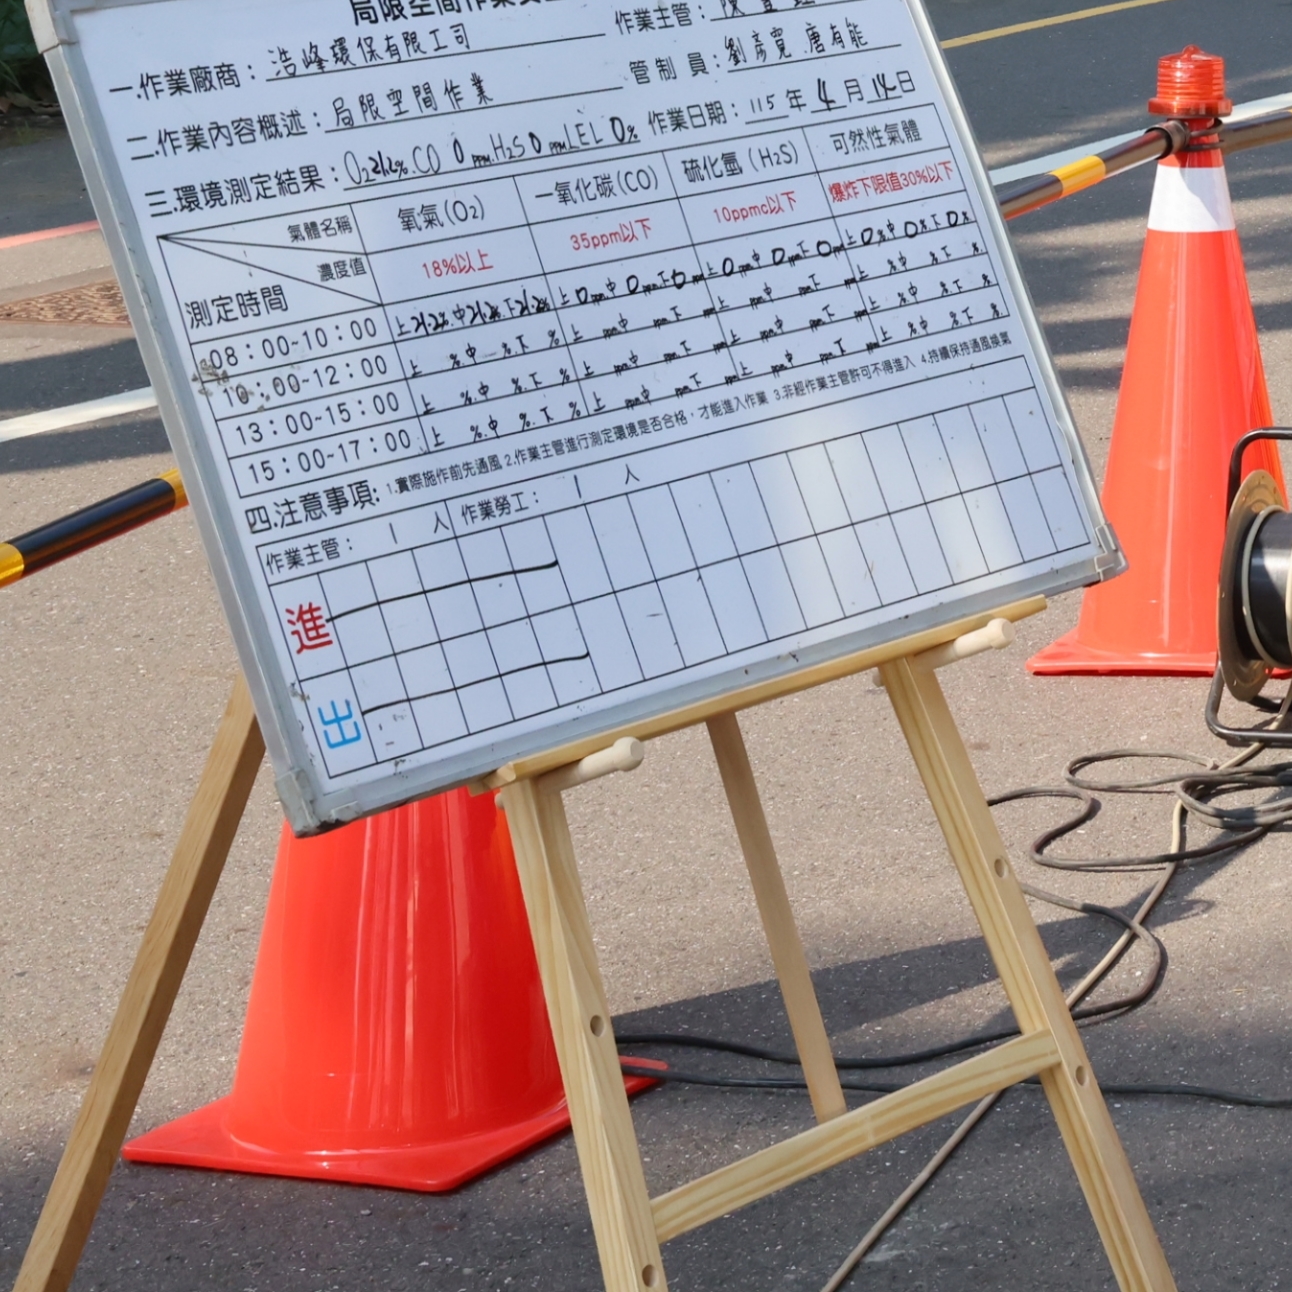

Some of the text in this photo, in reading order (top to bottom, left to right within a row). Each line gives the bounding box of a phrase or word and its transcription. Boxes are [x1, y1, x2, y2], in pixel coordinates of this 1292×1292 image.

[615, 2, 706, 36] 作業主管：
[333, 71, 493, 128] 局限空間作業
[648, 100, 739, 136] 作業日期：
[829, 119, 922, 156] 可然性氣體
[287, 215, 353, 243] 氣體名稱
[422, 161, 953, 279] 18%以上 35ppm以下 10ppmc以下 爆炸下限值30%以下
[317, 257, 368, 283] 濃度值
[185, 284, 289, 330] 測定時間
[386, 453, 501, 495] 1.實際施作前先通風
[774, 354, 915, 402] 3.非經作業主管許可不得進入
[921, 330, 1012, 367] 4.持續保持通風換氣
[461, 491, 540, 526] 作業勞工：
[265, 537, 354, 576] 作業主管：
[285, 601, 333, 655] 進
[317, 698, 362, 749] 出
